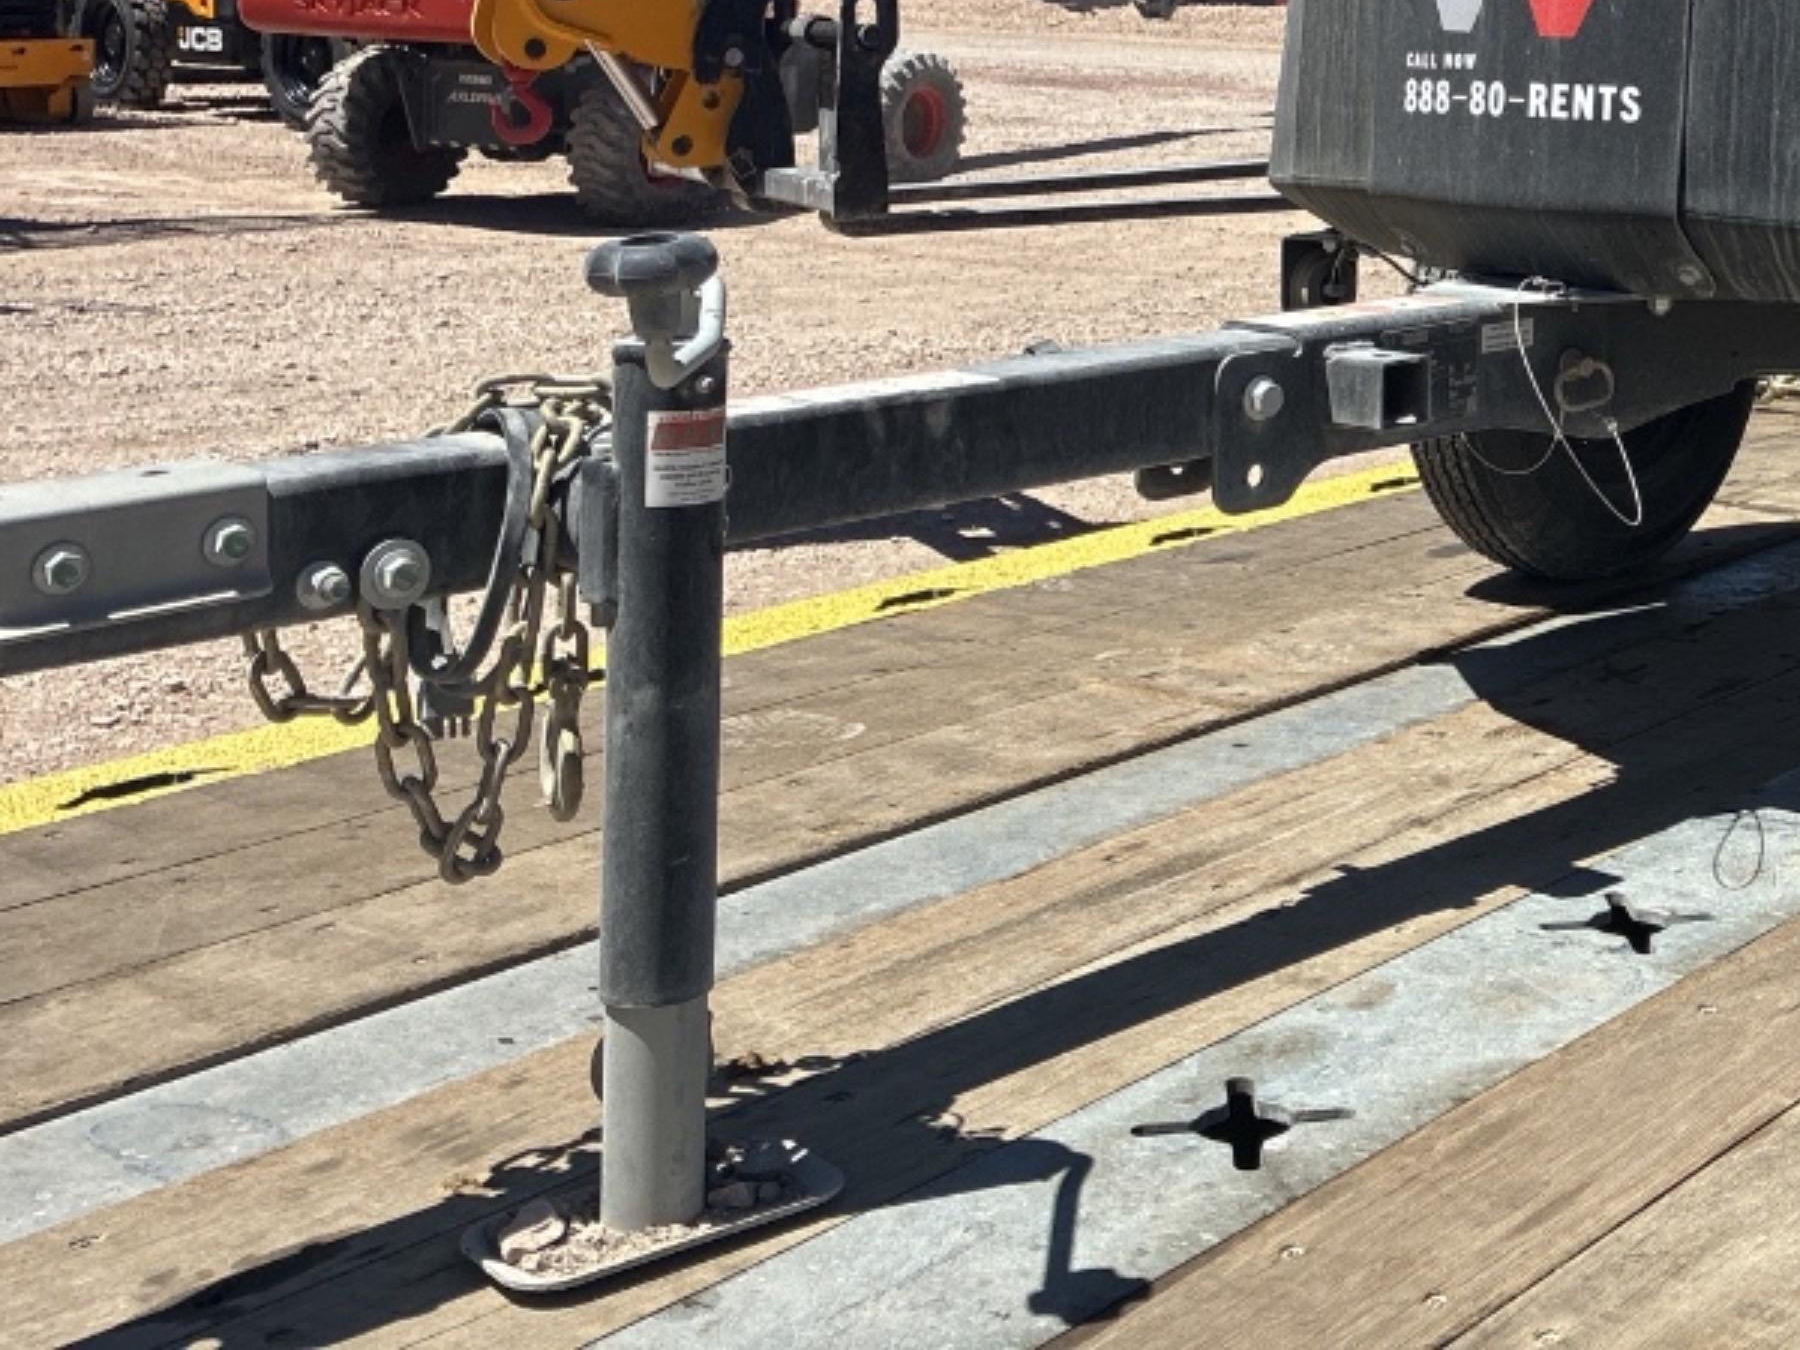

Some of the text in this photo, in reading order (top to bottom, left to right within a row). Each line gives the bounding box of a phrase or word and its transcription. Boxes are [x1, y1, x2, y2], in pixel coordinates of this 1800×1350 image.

[176, 26, 223, 52] JCB
[1406, 52, 1478, 70] CALL NOW
[1403, 77, 1642, 124] 888-80-RENTS
